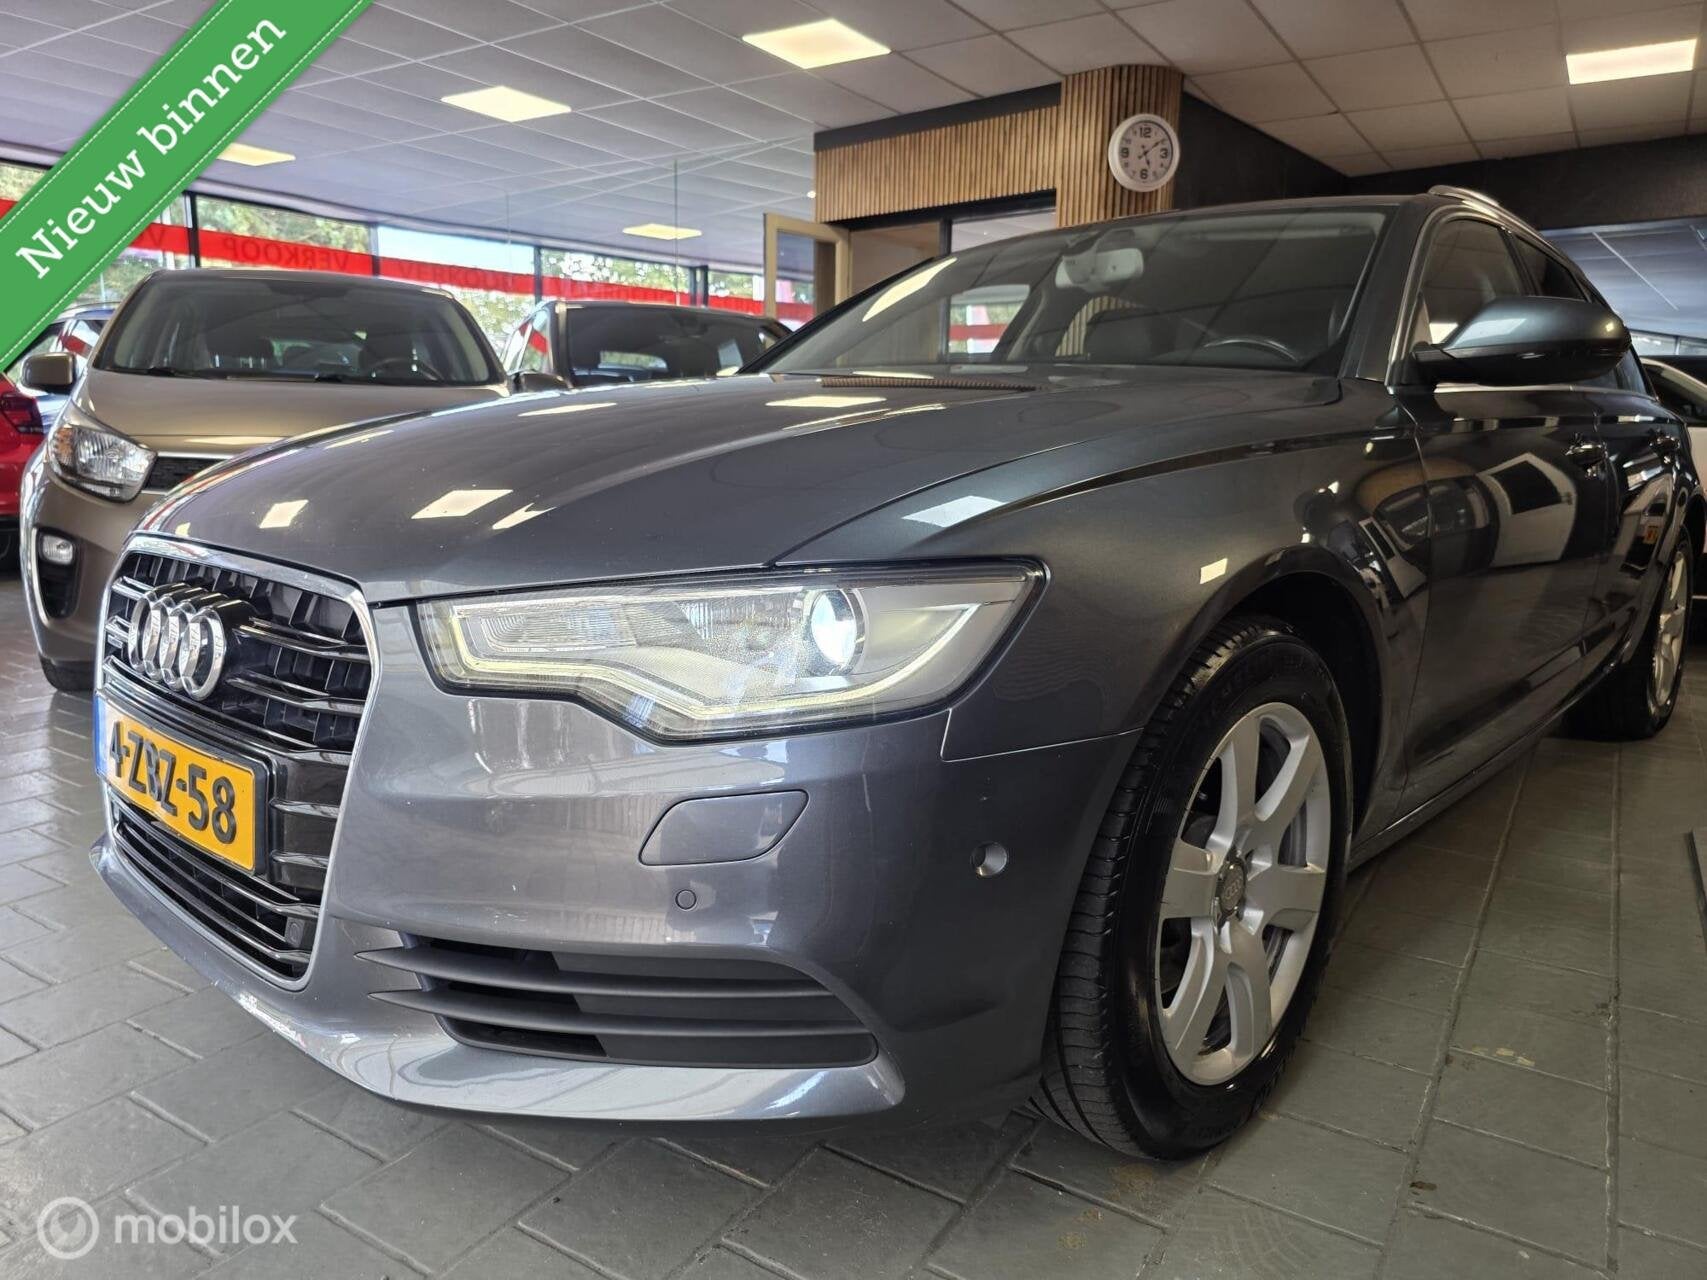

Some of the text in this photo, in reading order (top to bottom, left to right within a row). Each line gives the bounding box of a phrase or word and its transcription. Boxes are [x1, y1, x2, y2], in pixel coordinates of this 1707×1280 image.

[1139, 127, 1152, 138] 12
[1160, 148, 1169, 159] 3
[1140, 169, 1148, 180] 6
